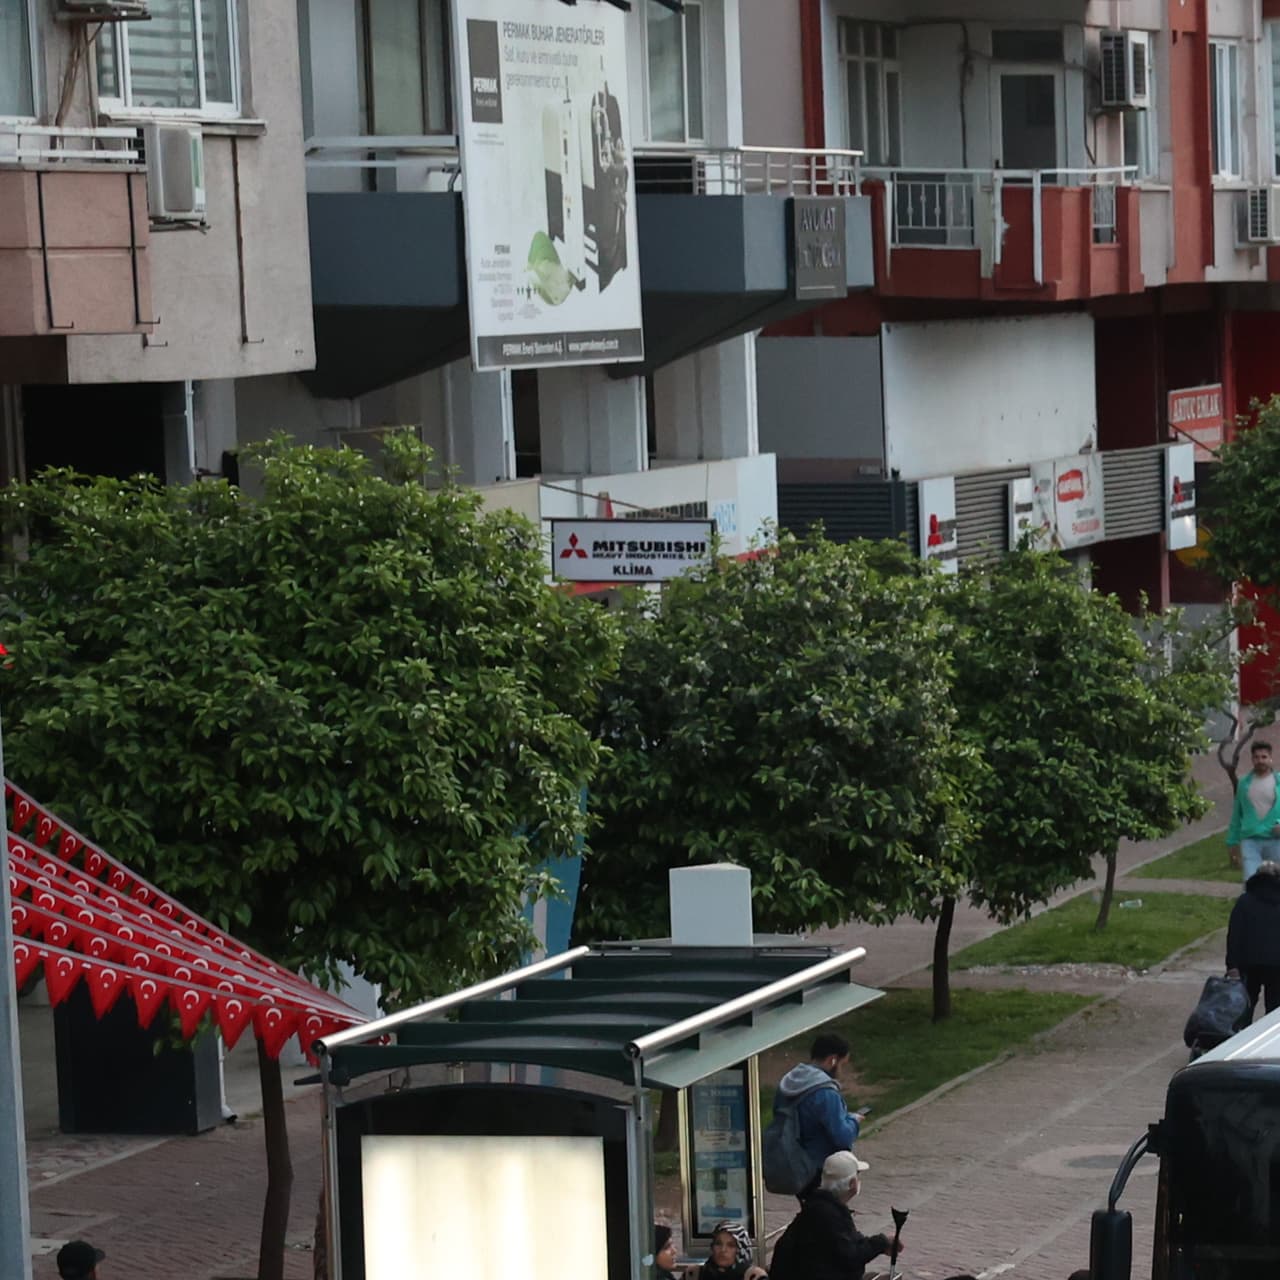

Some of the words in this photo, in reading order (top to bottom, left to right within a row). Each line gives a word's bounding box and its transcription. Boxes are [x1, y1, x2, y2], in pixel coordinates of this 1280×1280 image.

[531, 26, 554, 42] BUHAR
[592, 540, 706, 553] MITSUBISHI
[592, 552, 622, 560] HEAVY
[612, 563, 654, 576] KLİMA
